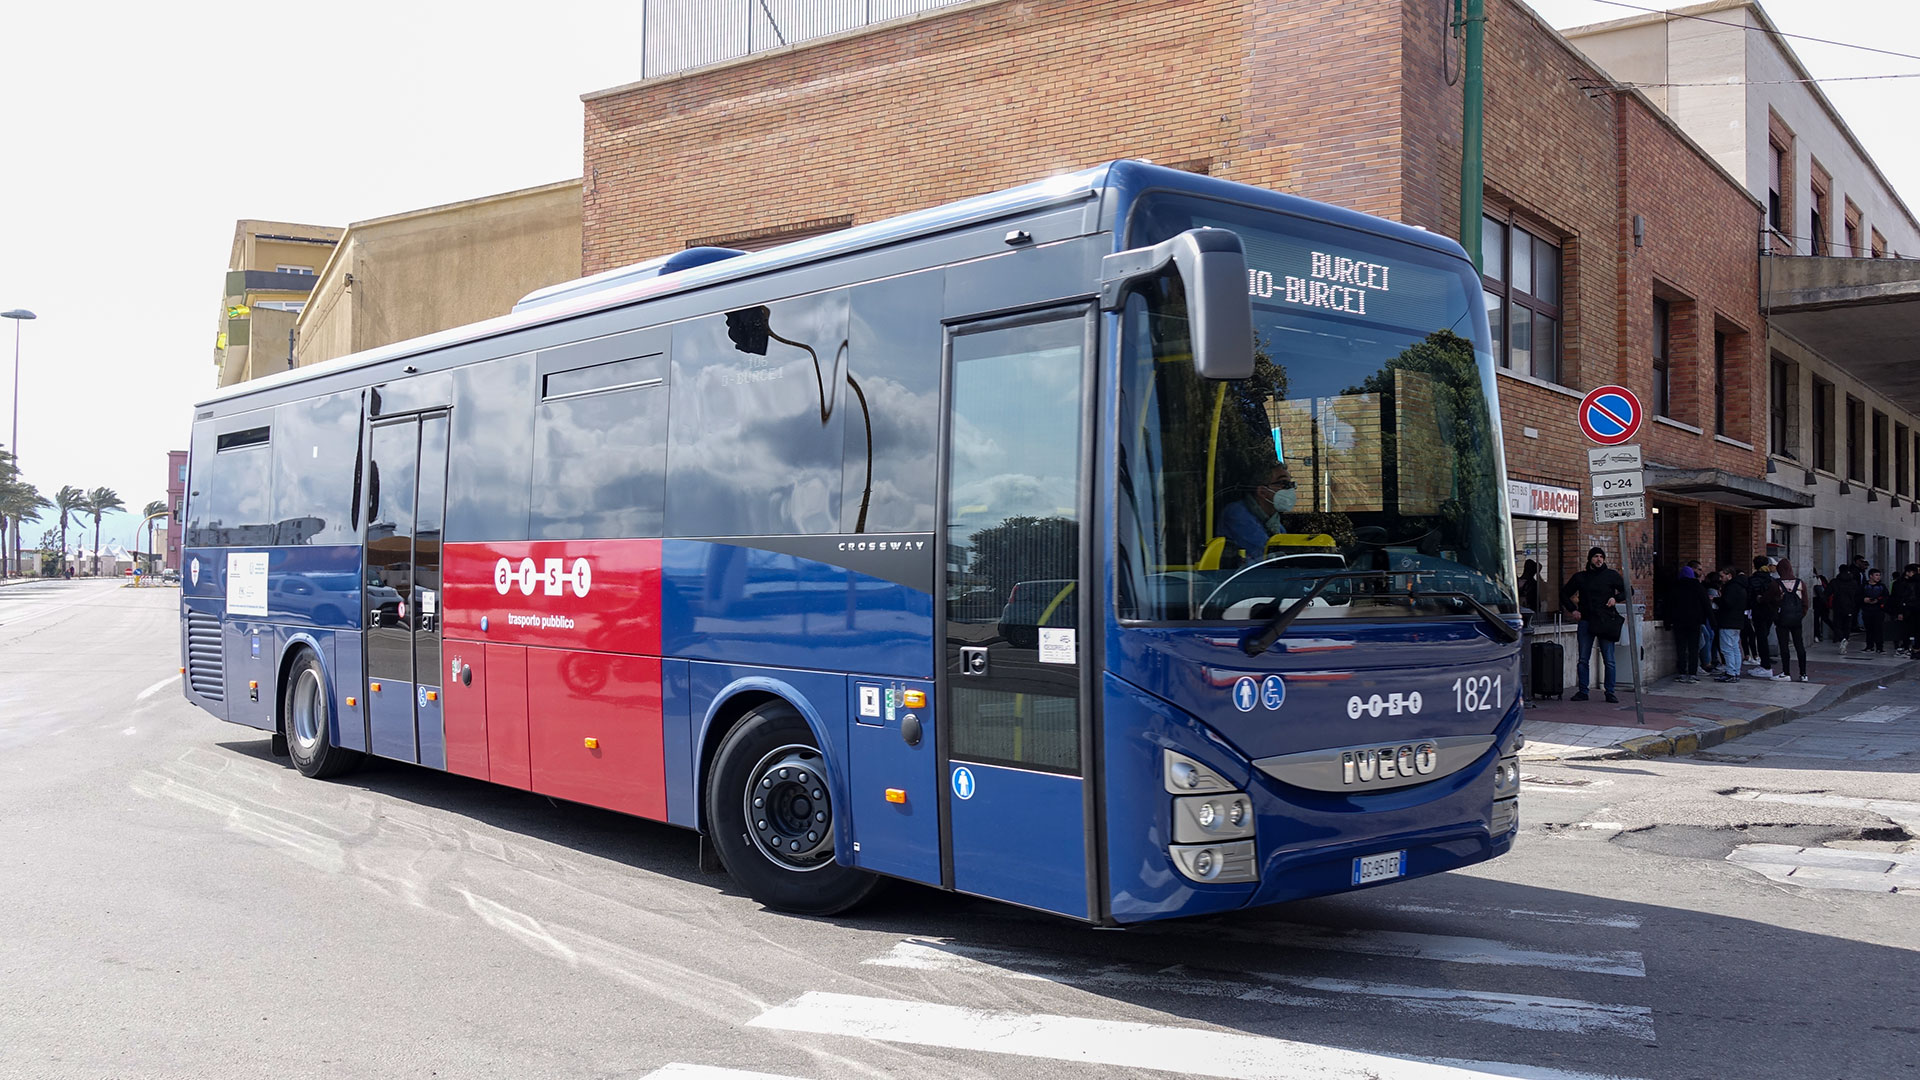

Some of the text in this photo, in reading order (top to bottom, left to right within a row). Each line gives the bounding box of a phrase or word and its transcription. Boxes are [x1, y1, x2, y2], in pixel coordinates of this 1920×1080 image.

[1311, 252, 1389, 291] BURCEI
[1603, 479, 1632, 490] 0-24
[1532, 490, 1577, 514] TABACCHI
[838, 541, 924, 551] CROSSWAY
[497, 562, 588, 593] arst
[508, 613, 574, 629] trasporto pubblico
[1349, 692, 1420, 717] arst
[1452, 674, 1502, 713] 1821
[1341, 743, 1437, 785] IVECO
